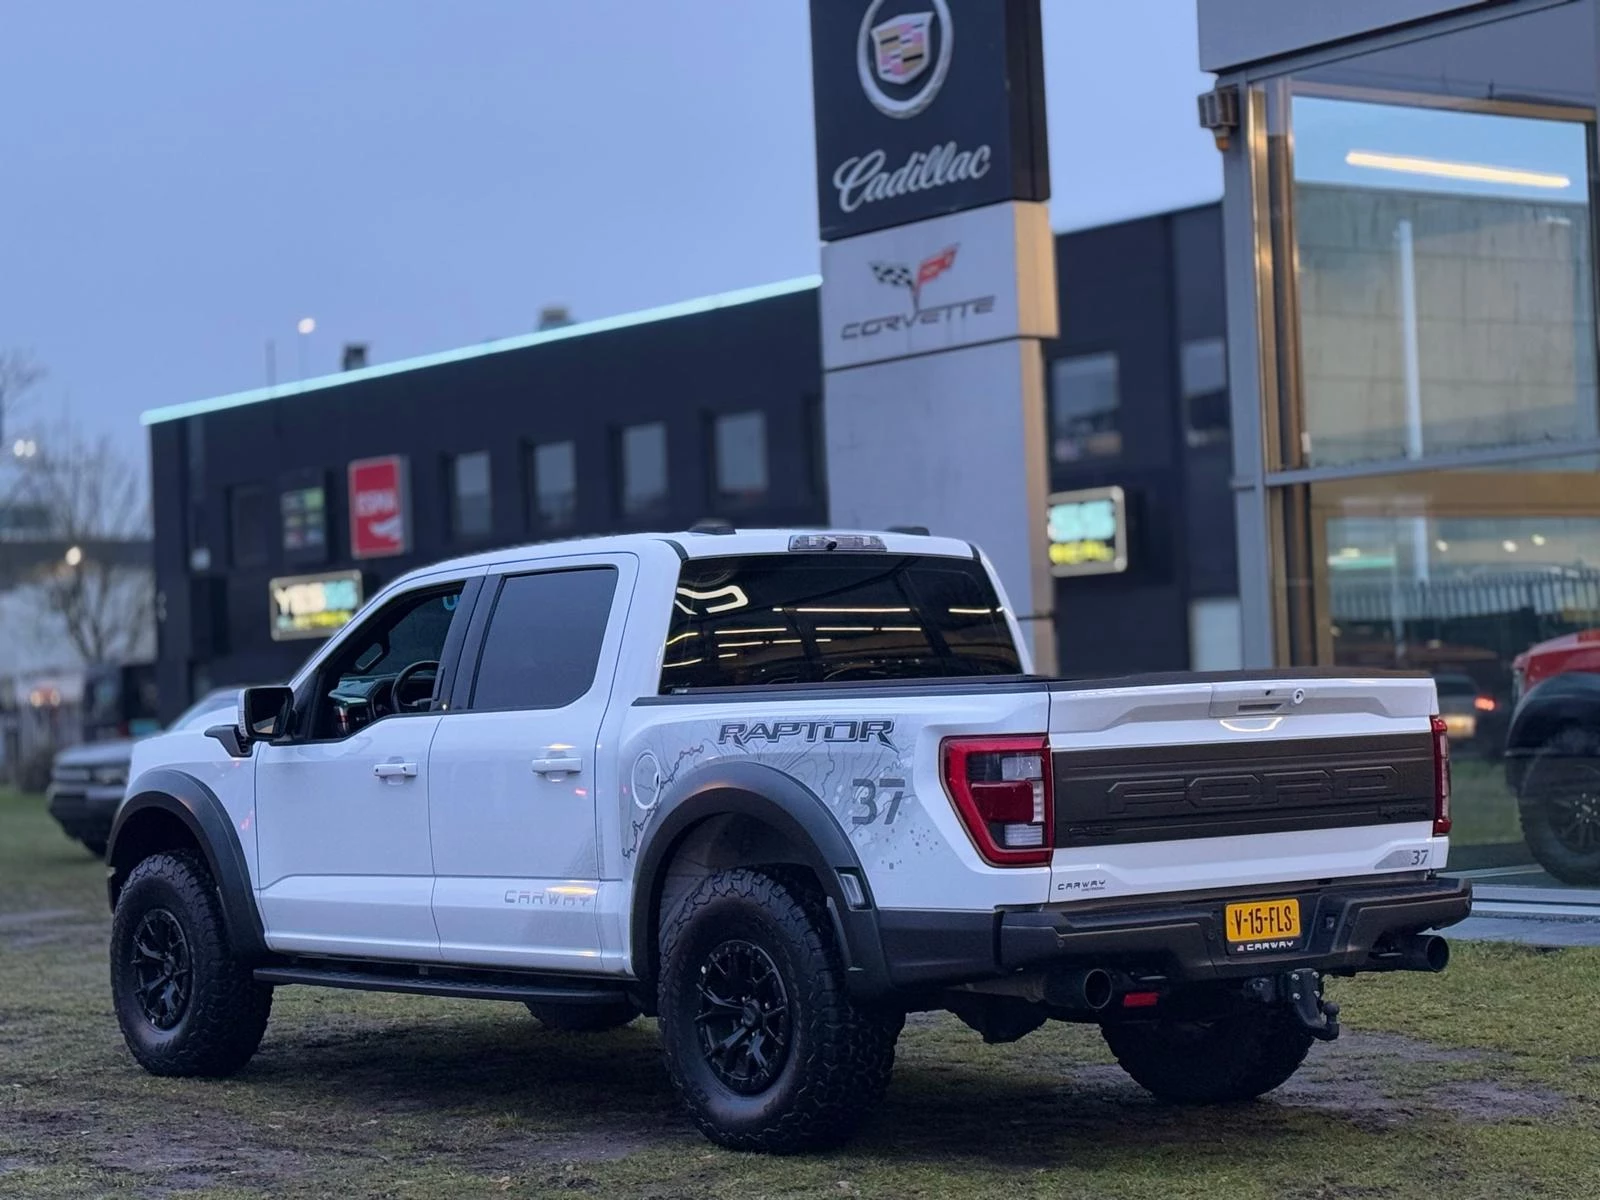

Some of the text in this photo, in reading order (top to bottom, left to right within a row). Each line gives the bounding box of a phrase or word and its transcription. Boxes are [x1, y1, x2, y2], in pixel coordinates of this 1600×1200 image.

[833, 141, 991, 213] Cadillac
[840, 295, 995, 340] CORVETTE
[718, 719, 899, 753] RAPTOR
[852, 778, 905, 825] 37
[1106, 765, 1399, 815] FORD
[1411, 849, 1429, 865] 37
[504, 889, 592, 906] CARWAY
[1057, 880, 1105, 890] CARWAY
[1234, 905, 1293, 936] V-15-FLS
[1246, 940, 1294, 951] CARWAY
